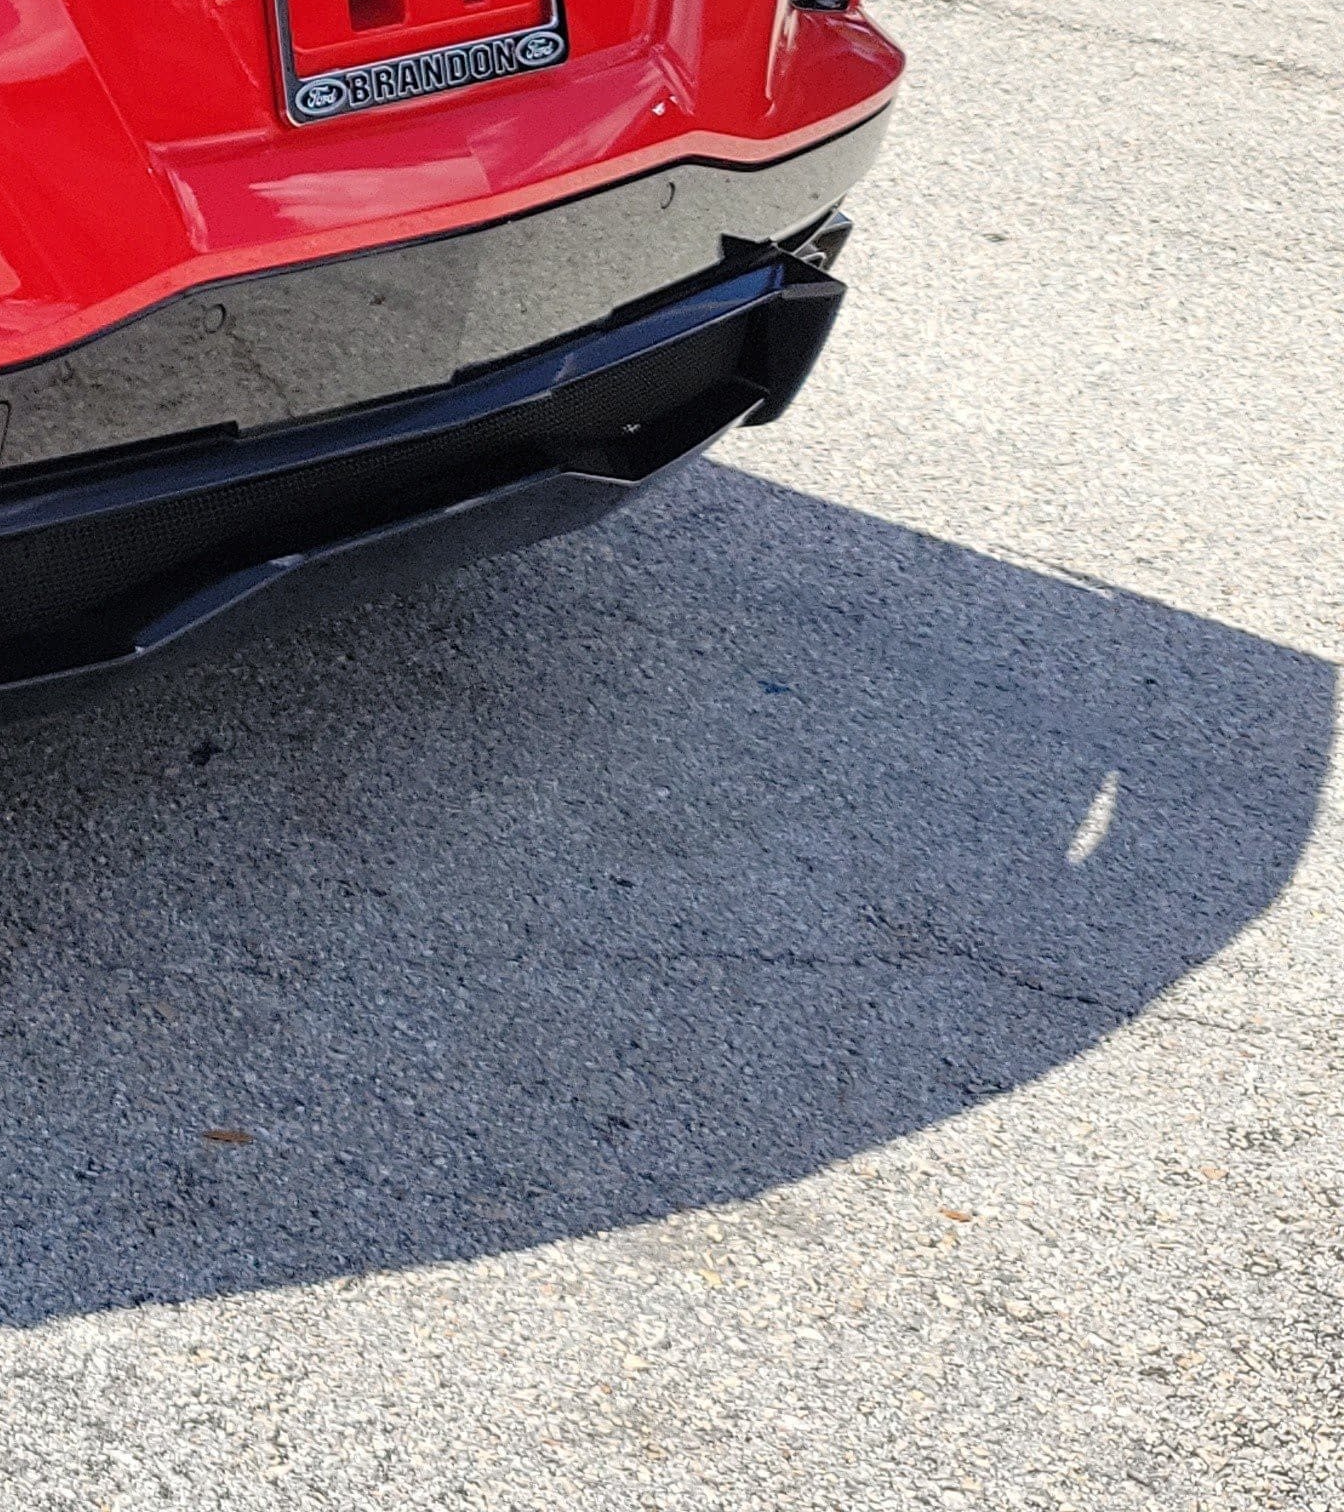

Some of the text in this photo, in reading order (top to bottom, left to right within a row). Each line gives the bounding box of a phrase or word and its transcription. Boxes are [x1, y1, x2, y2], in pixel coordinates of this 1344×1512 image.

[306, 36, 554, 108] Ford BRANDON Ford
